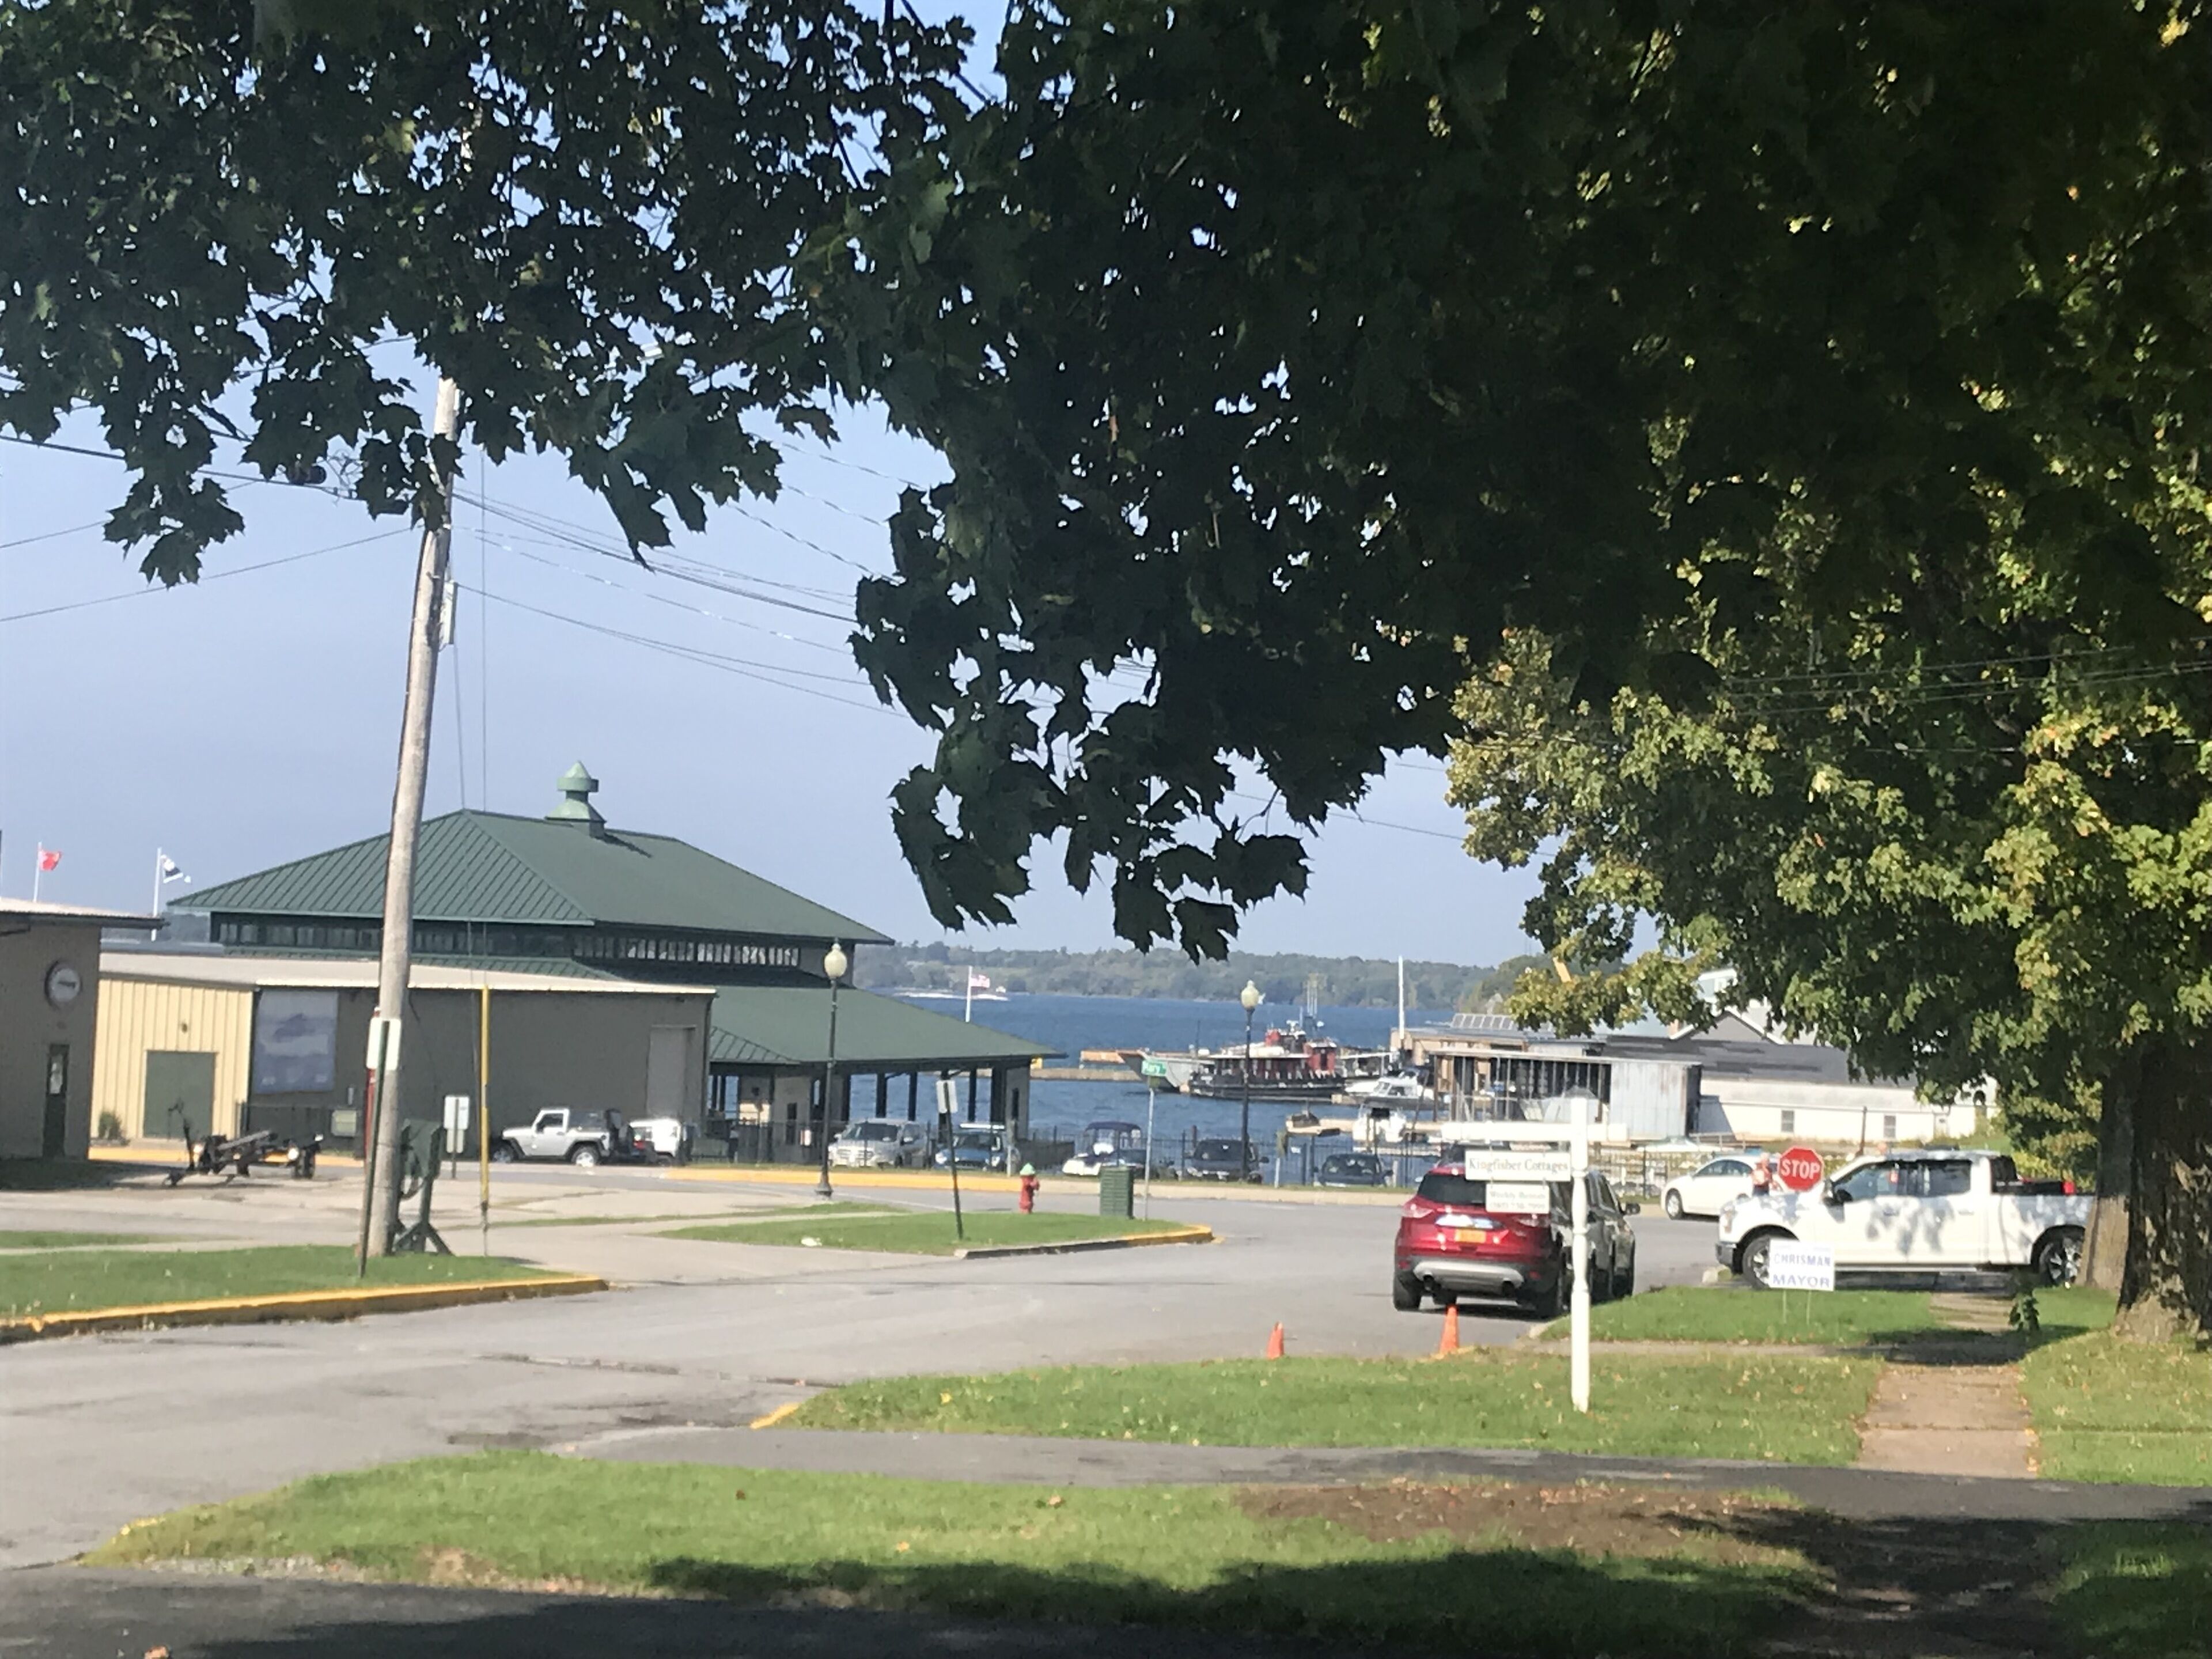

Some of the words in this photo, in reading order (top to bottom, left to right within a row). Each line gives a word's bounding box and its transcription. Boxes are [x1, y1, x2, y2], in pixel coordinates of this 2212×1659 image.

[1469, 1157, 1522, 1173] Kingfisher
[1524, 1158, 1568, 1174] Cottages
[1781, 1158, 1820, 1180] STOP
[1774, 1253, 1831, 1267] CHRISMAN
[1773, 1274, 1830, 1288] MAYOR
